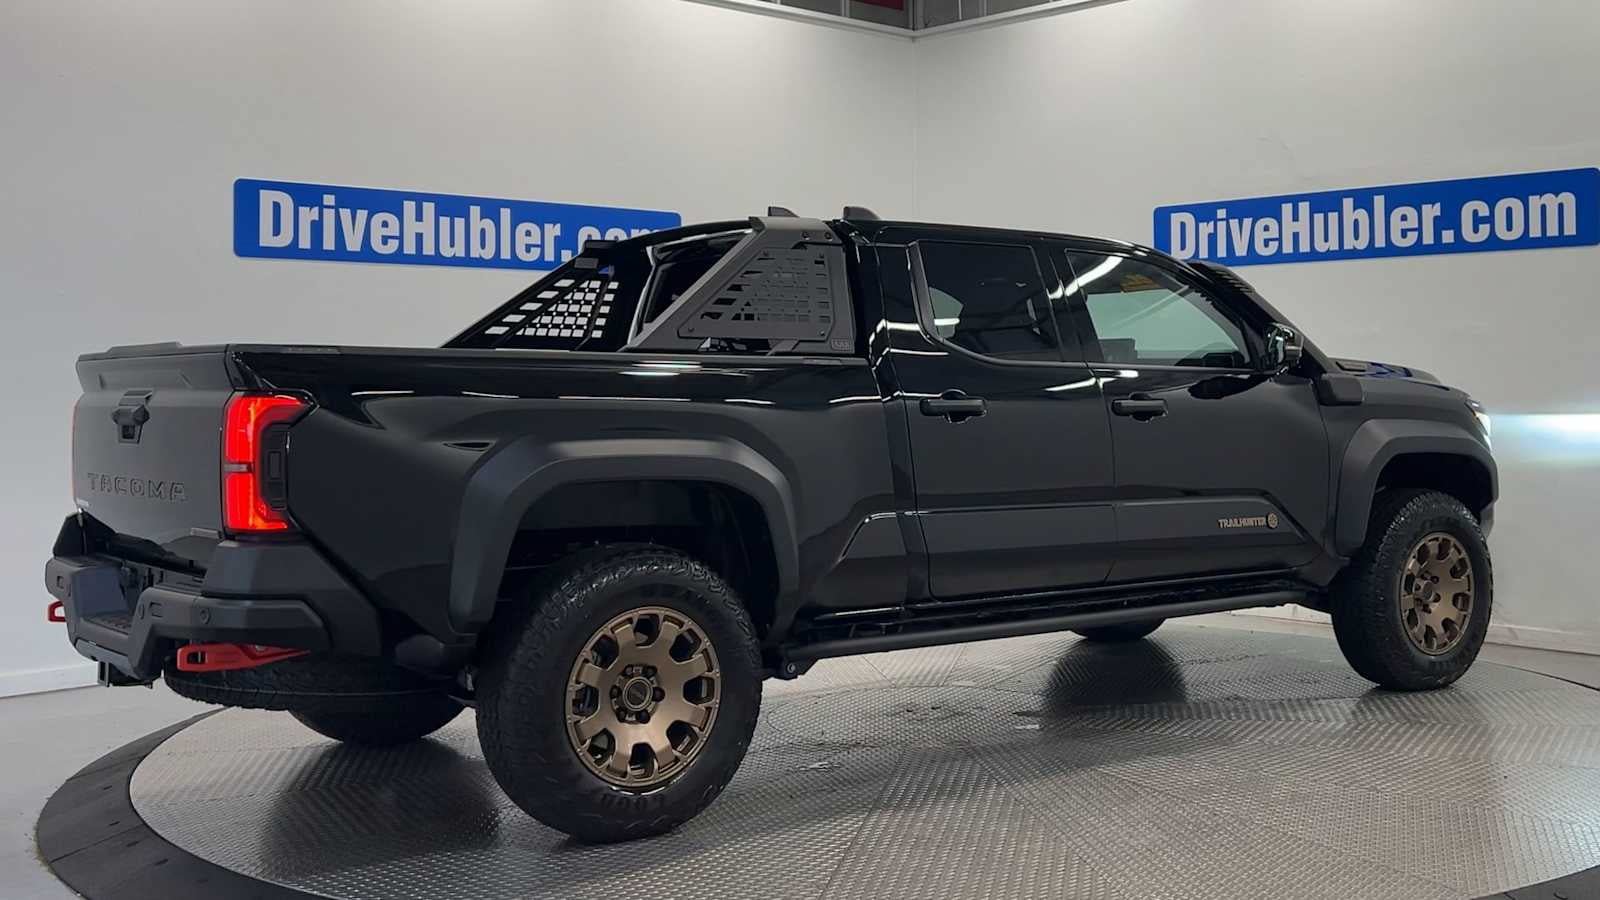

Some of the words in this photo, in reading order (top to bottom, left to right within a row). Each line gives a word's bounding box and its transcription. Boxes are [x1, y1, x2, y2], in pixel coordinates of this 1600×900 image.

[1170, 191, 1577, 260] DriveHubler.com
[87, 472, 187, 501] TACOMA
[1218, 516, 1266, 529] TRAILHUNTER
